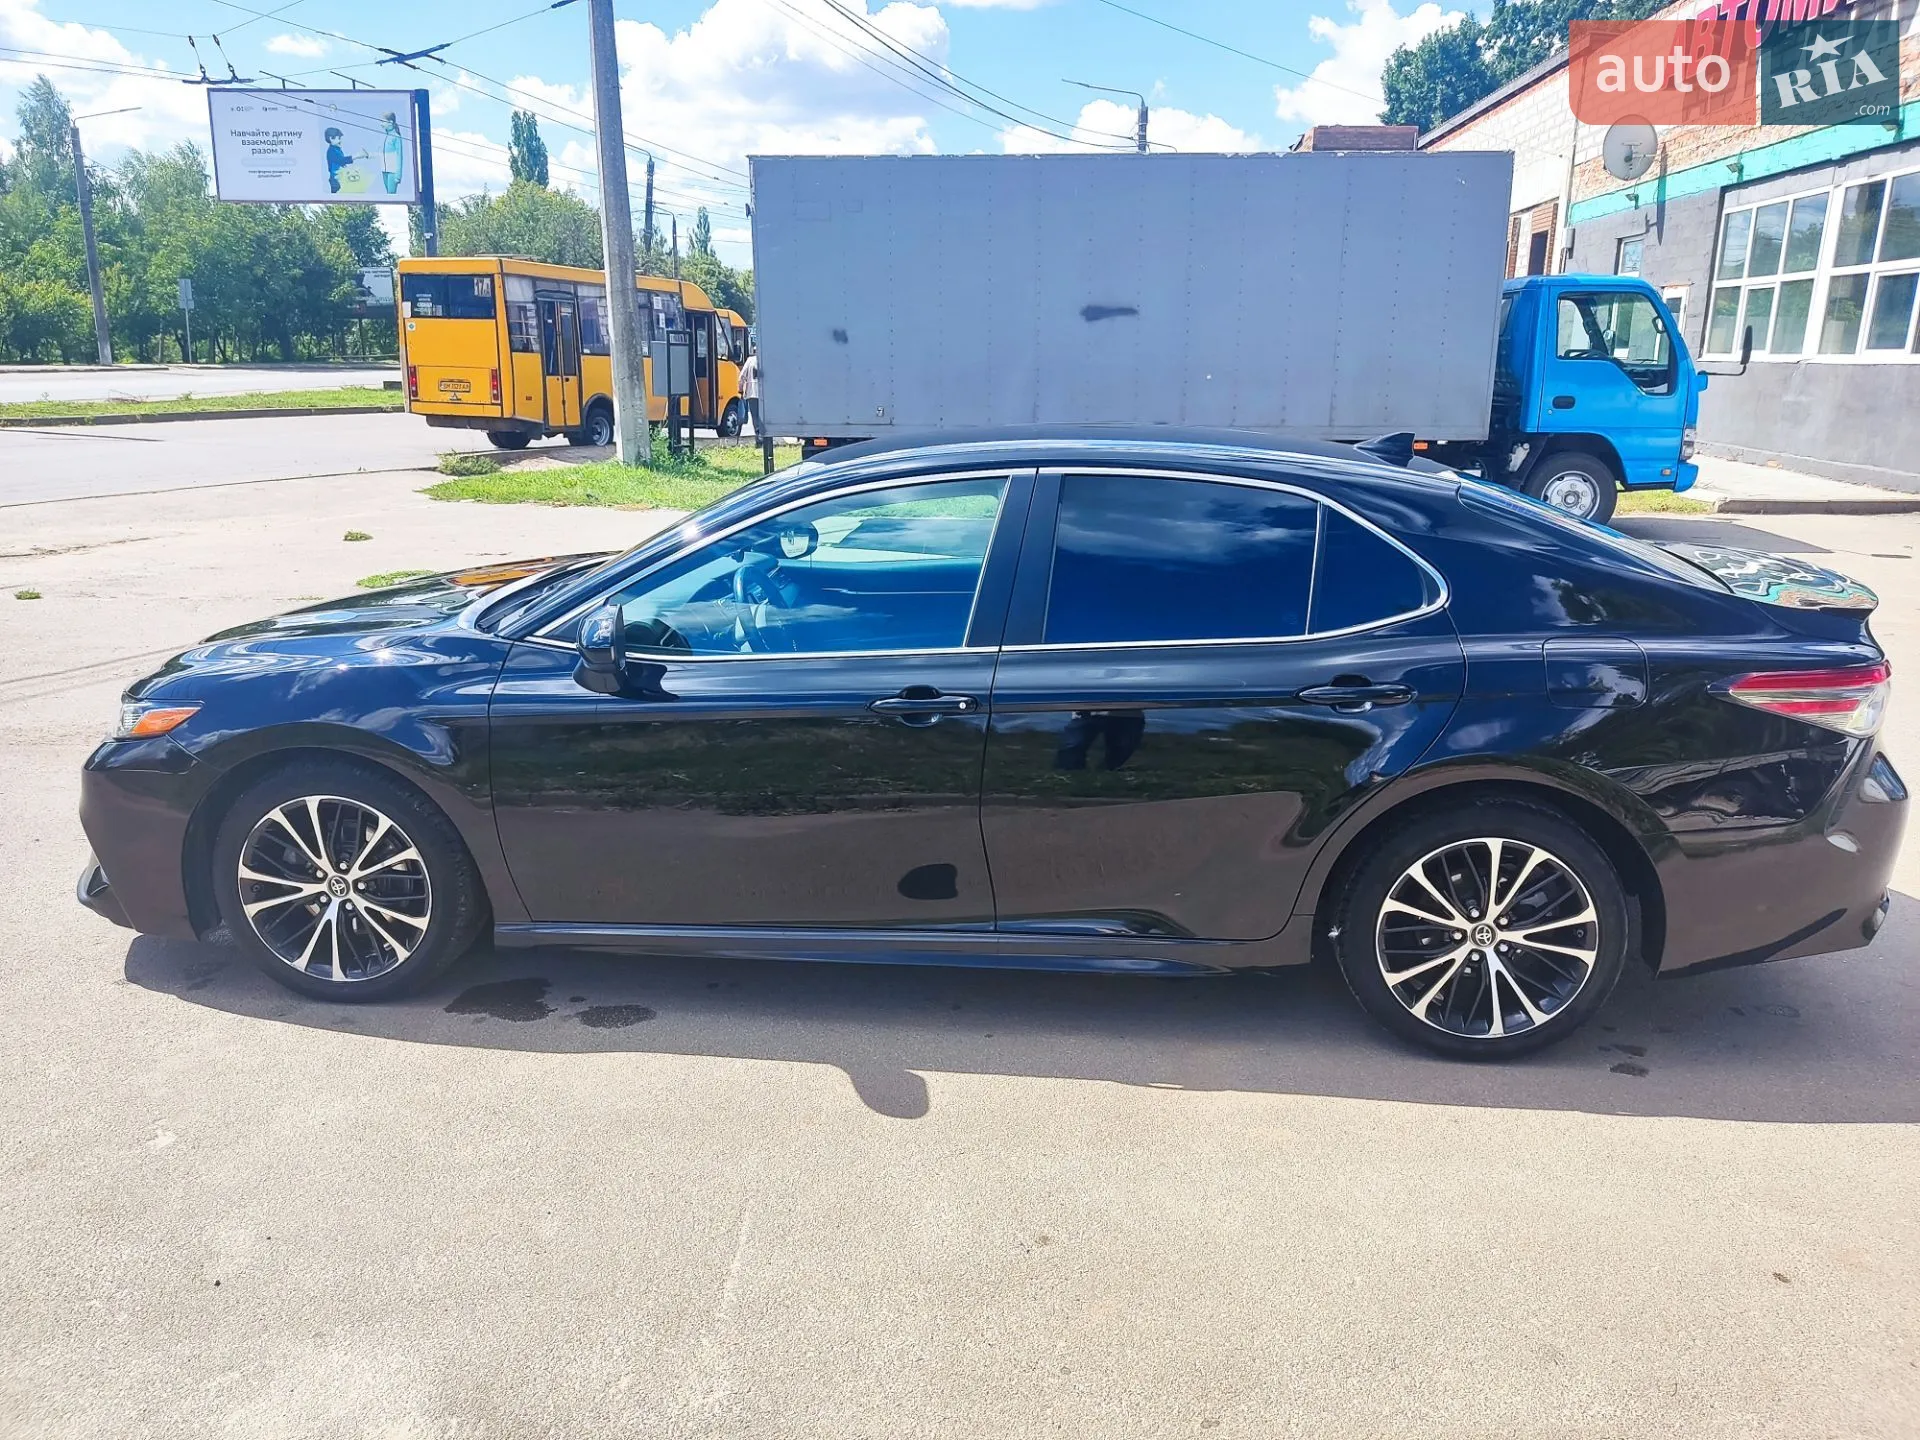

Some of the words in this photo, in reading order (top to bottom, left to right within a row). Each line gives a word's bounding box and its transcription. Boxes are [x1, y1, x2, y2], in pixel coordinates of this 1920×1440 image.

[230, 128, 271, 137] Навчайте
[272, 130, 303, 139] дитину
[241, 139, 294, 147] взаємодіяти
[251, 148, 278, 156] разом
